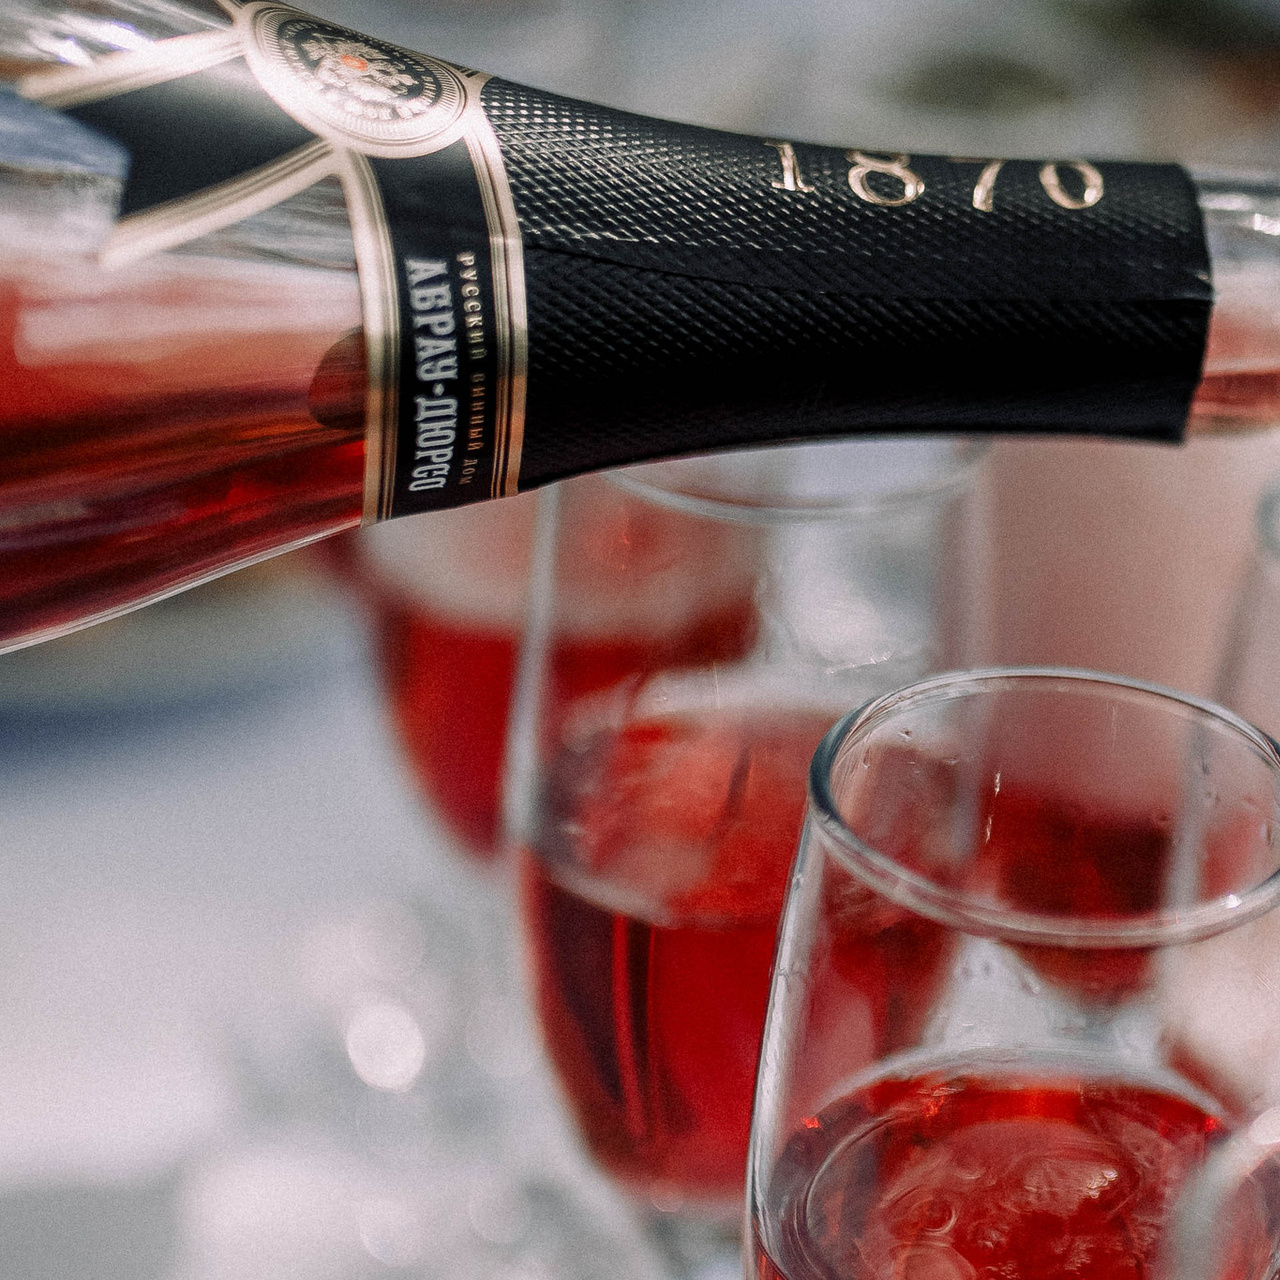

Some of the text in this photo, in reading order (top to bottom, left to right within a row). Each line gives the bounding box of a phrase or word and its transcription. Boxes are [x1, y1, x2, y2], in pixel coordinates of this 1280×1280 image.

[764, 139, 1104, 212] 1870
[456, 251, 487, 485] РУССКИЙ ВИННЫЙ ДОМ
